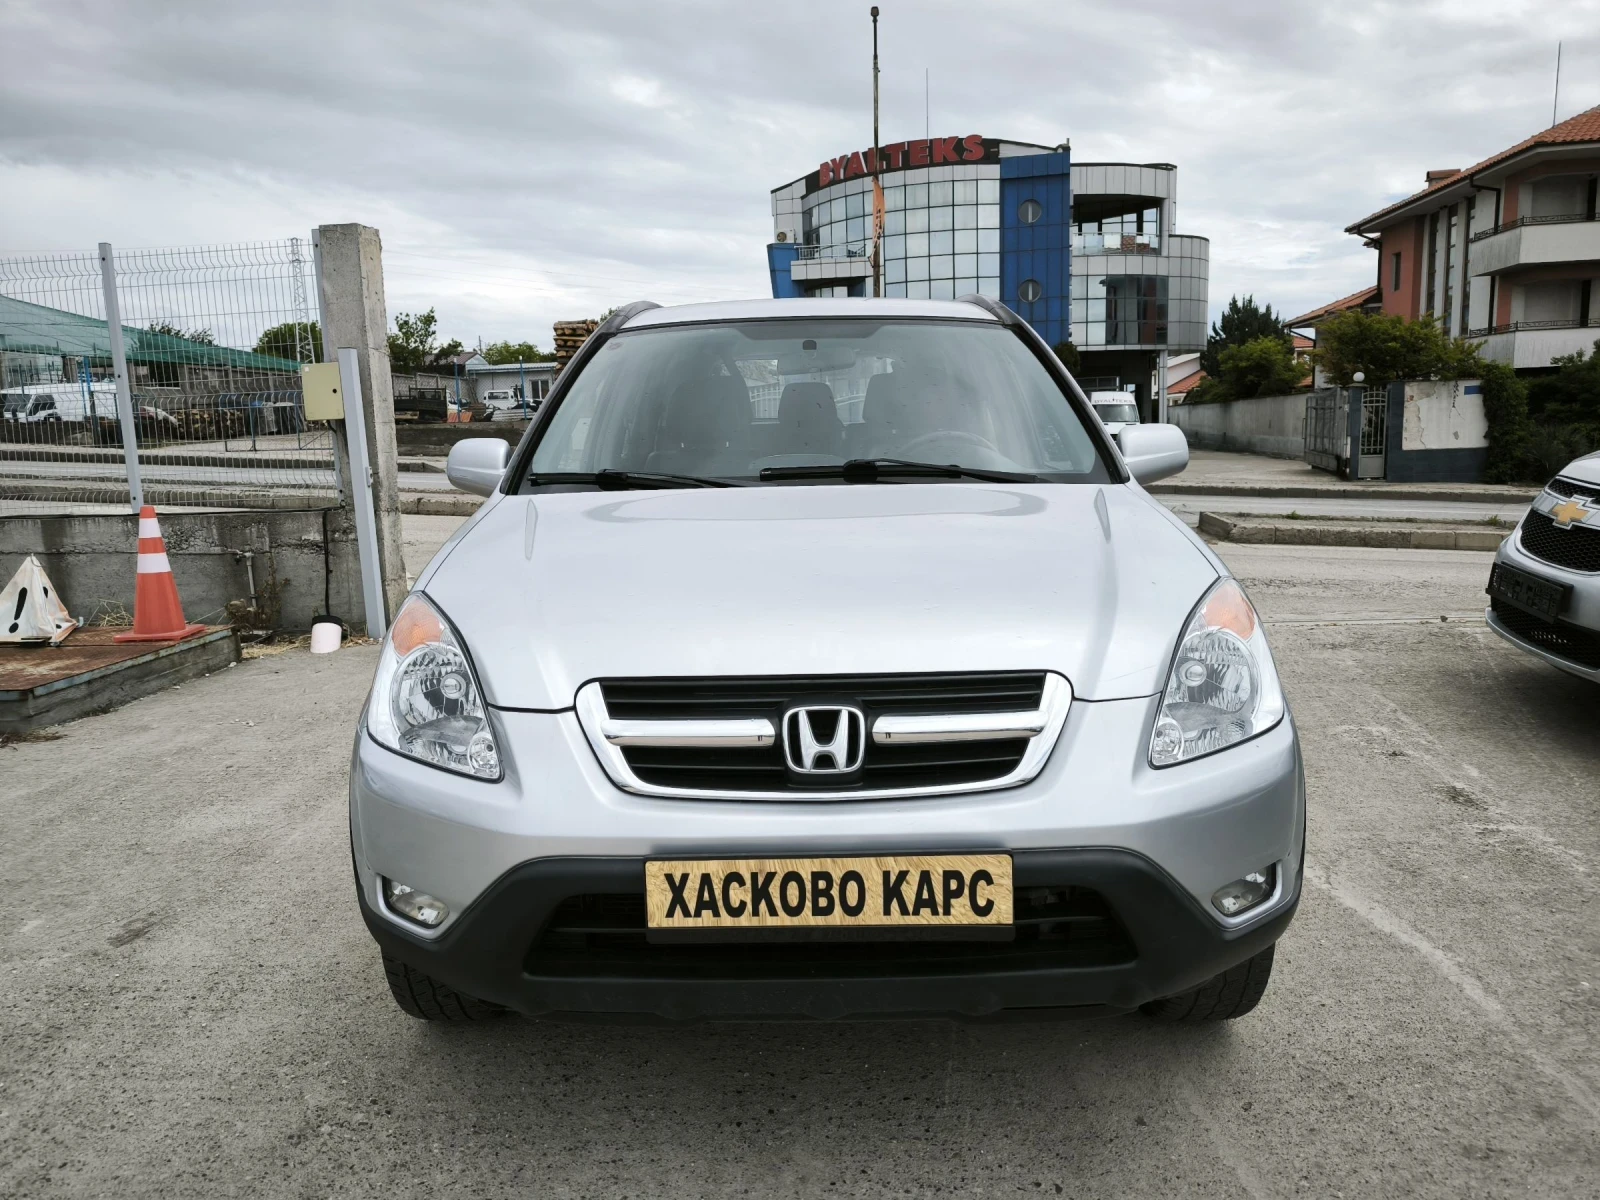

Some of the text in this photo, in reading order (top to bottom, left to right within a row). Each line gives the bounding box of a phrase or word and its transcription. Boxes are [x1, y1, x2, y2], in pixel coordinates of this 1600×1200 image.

[820, 134, 985, 187] BYALTEKS
[664, 869, 995, 918] ХАСКОВО КАРС
